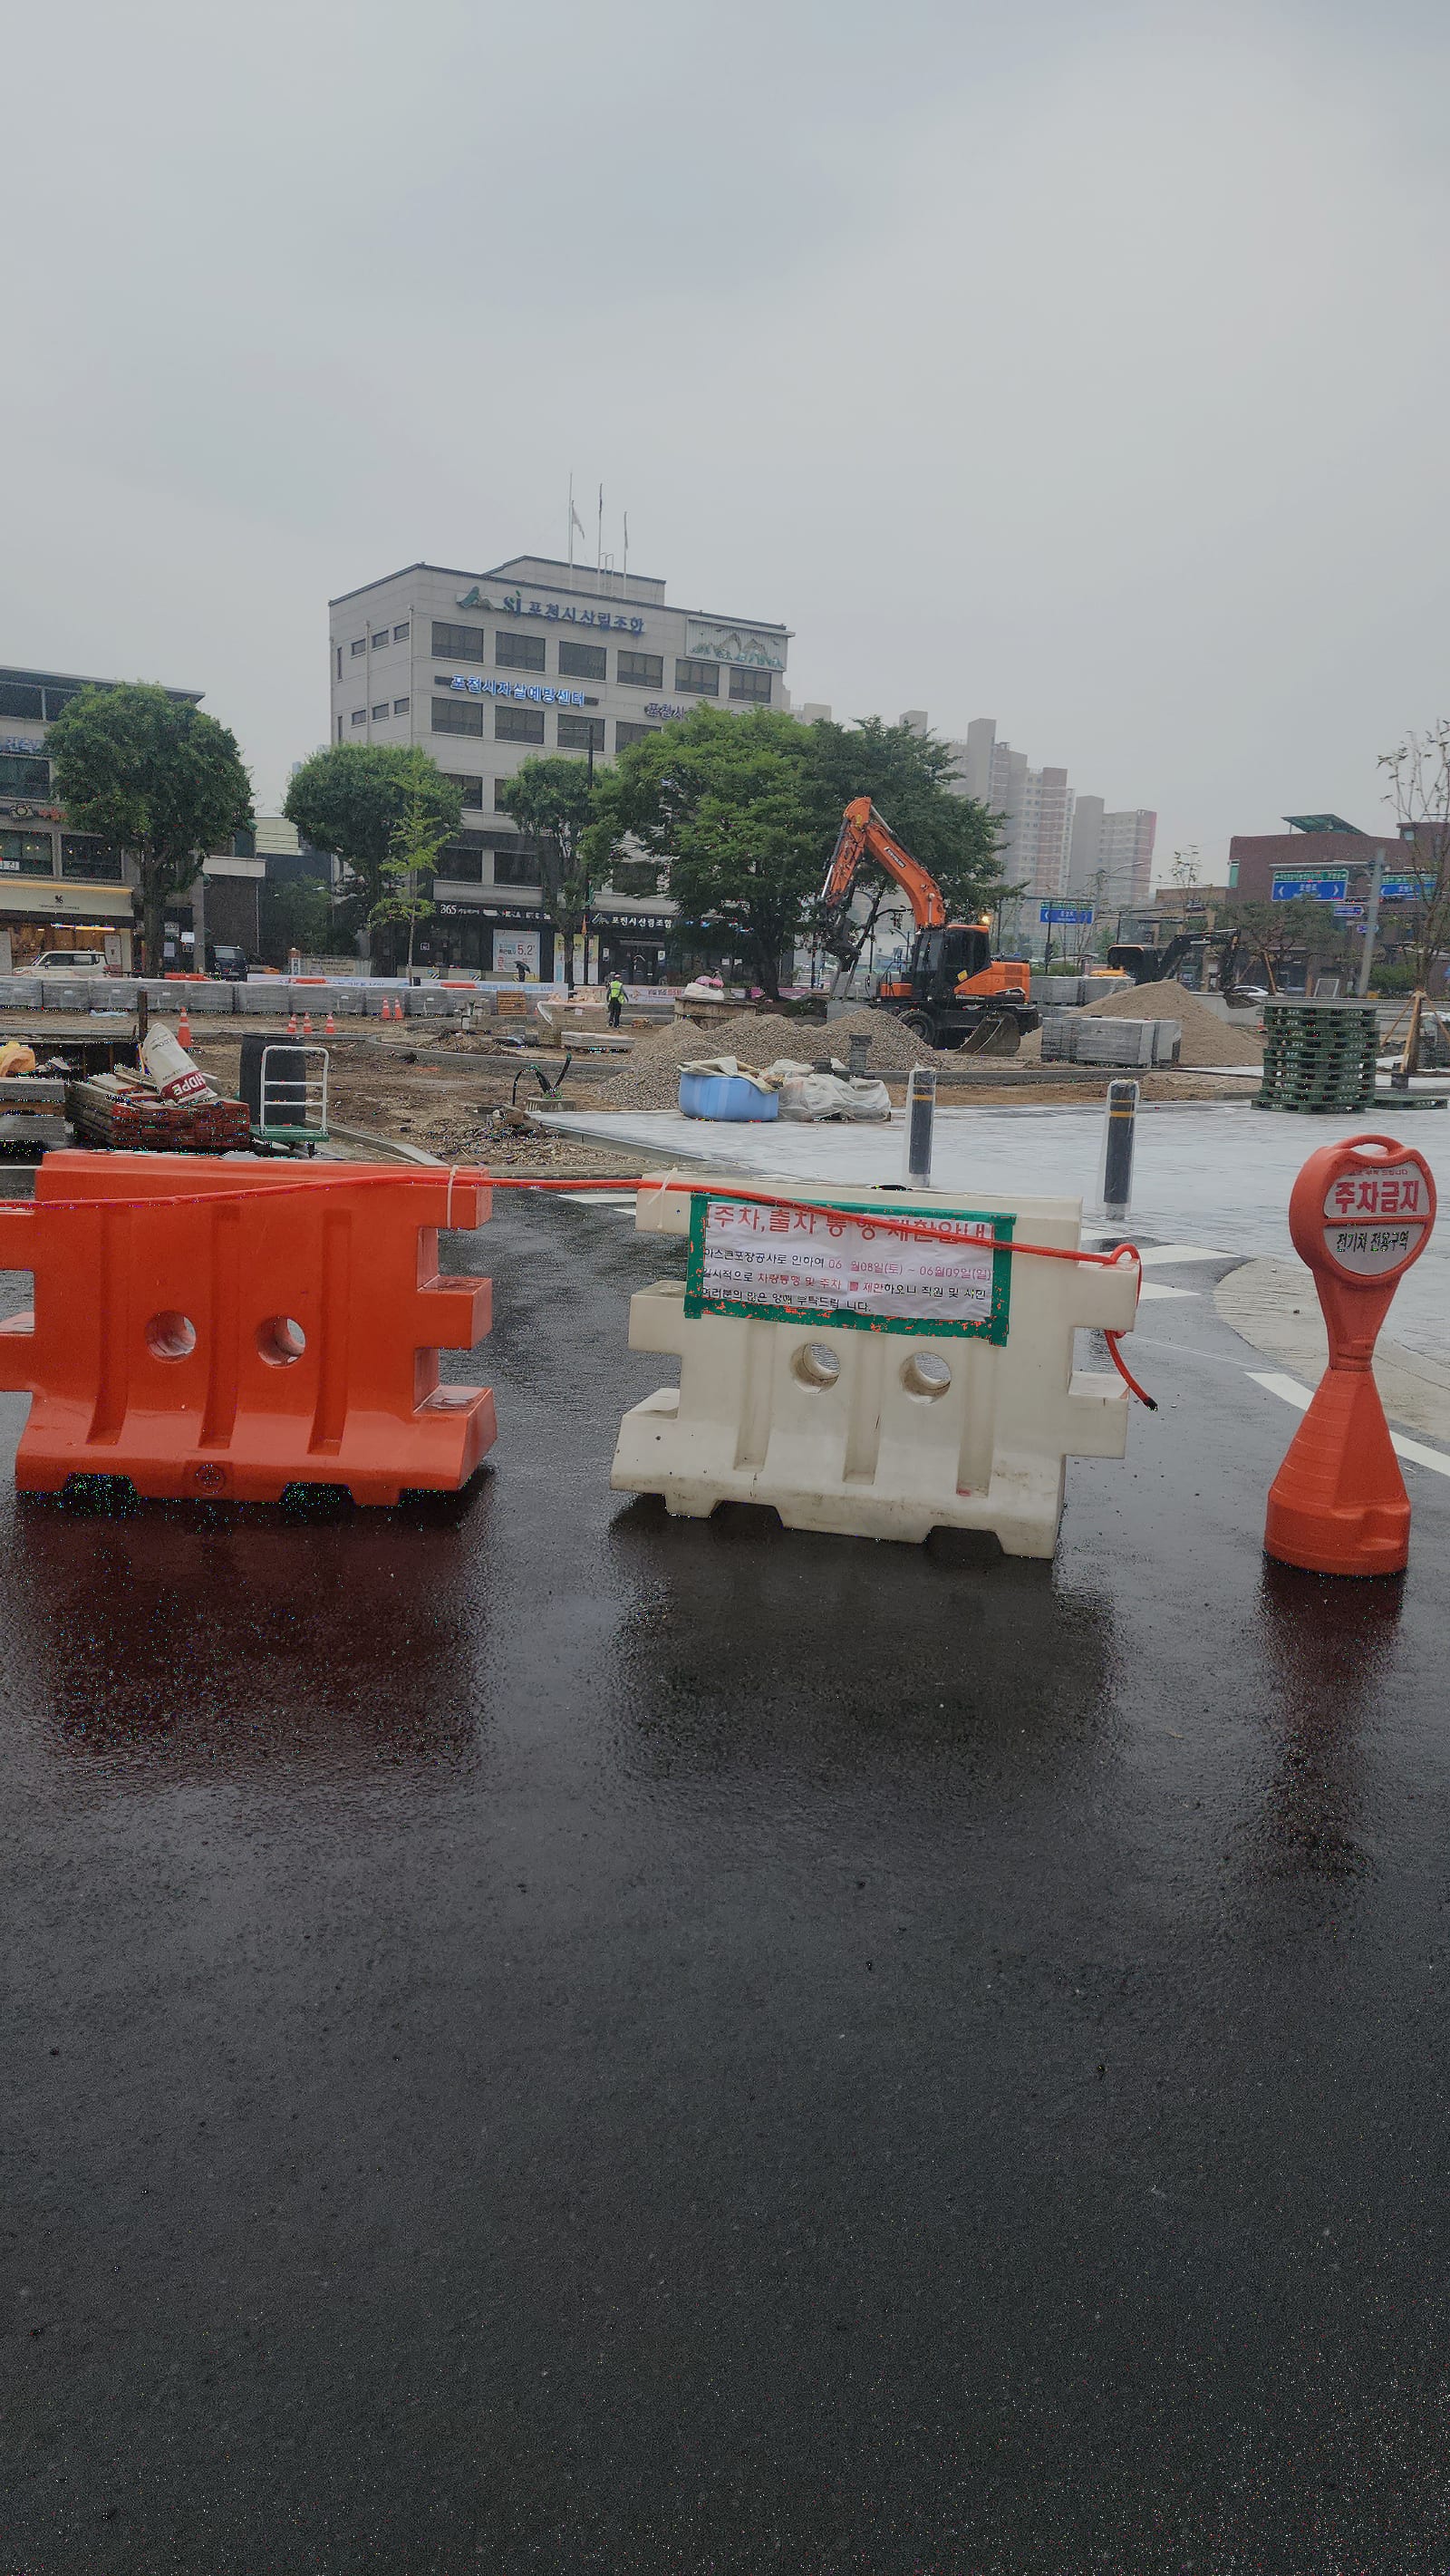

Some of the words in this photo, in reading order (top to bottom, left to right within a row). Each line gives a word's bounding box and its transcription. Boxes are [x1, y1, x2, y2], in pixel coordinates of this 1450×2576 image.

[440, 904, 457, 915] 365
[171, 1073, 206, 1096] HDPE
[1335, 1180, 1420, 1215] 주차금지
[1336, 1233, 1368, 1253] 전기차
[1370, 1230, 1409, 1252] 전용구역
[792, 1254, 825, 1268] 인하여
[922, 1285, 943, 1298] 직원
[949, 1287, 960, 1298] 및
[963, 1289, 986, 1301] 시민
